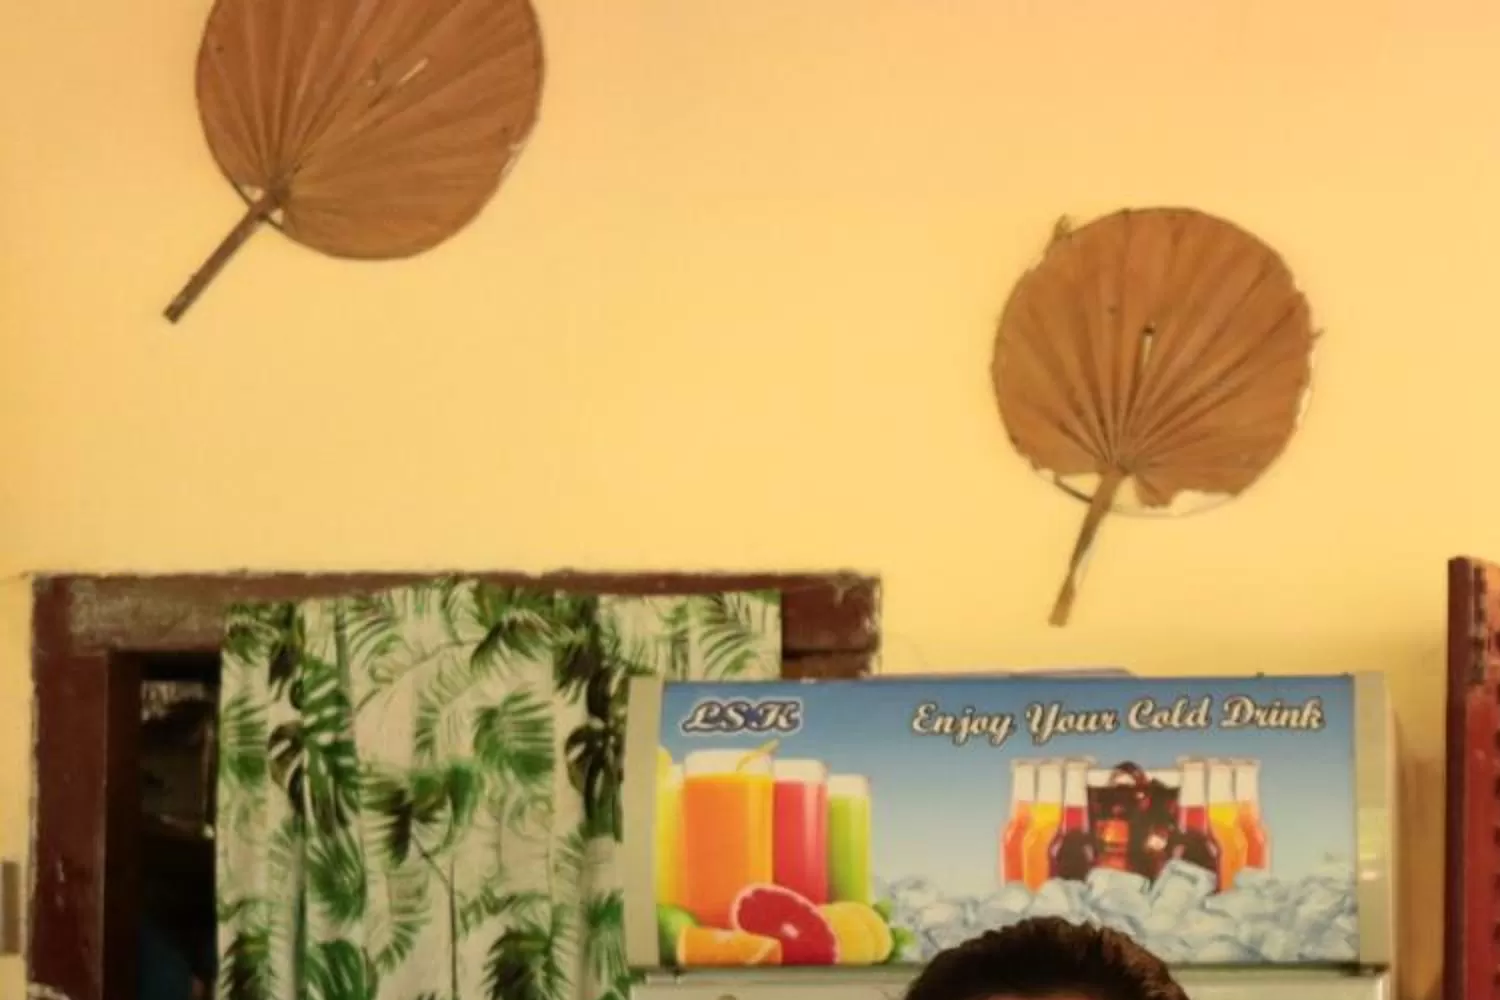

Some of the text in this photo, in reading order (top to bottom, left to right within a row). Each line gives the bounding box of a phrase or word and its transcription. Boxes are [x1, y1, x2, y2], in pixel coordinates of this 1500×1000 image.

[911, 695, 1324, 745] Enjoy Your Cold Drink
